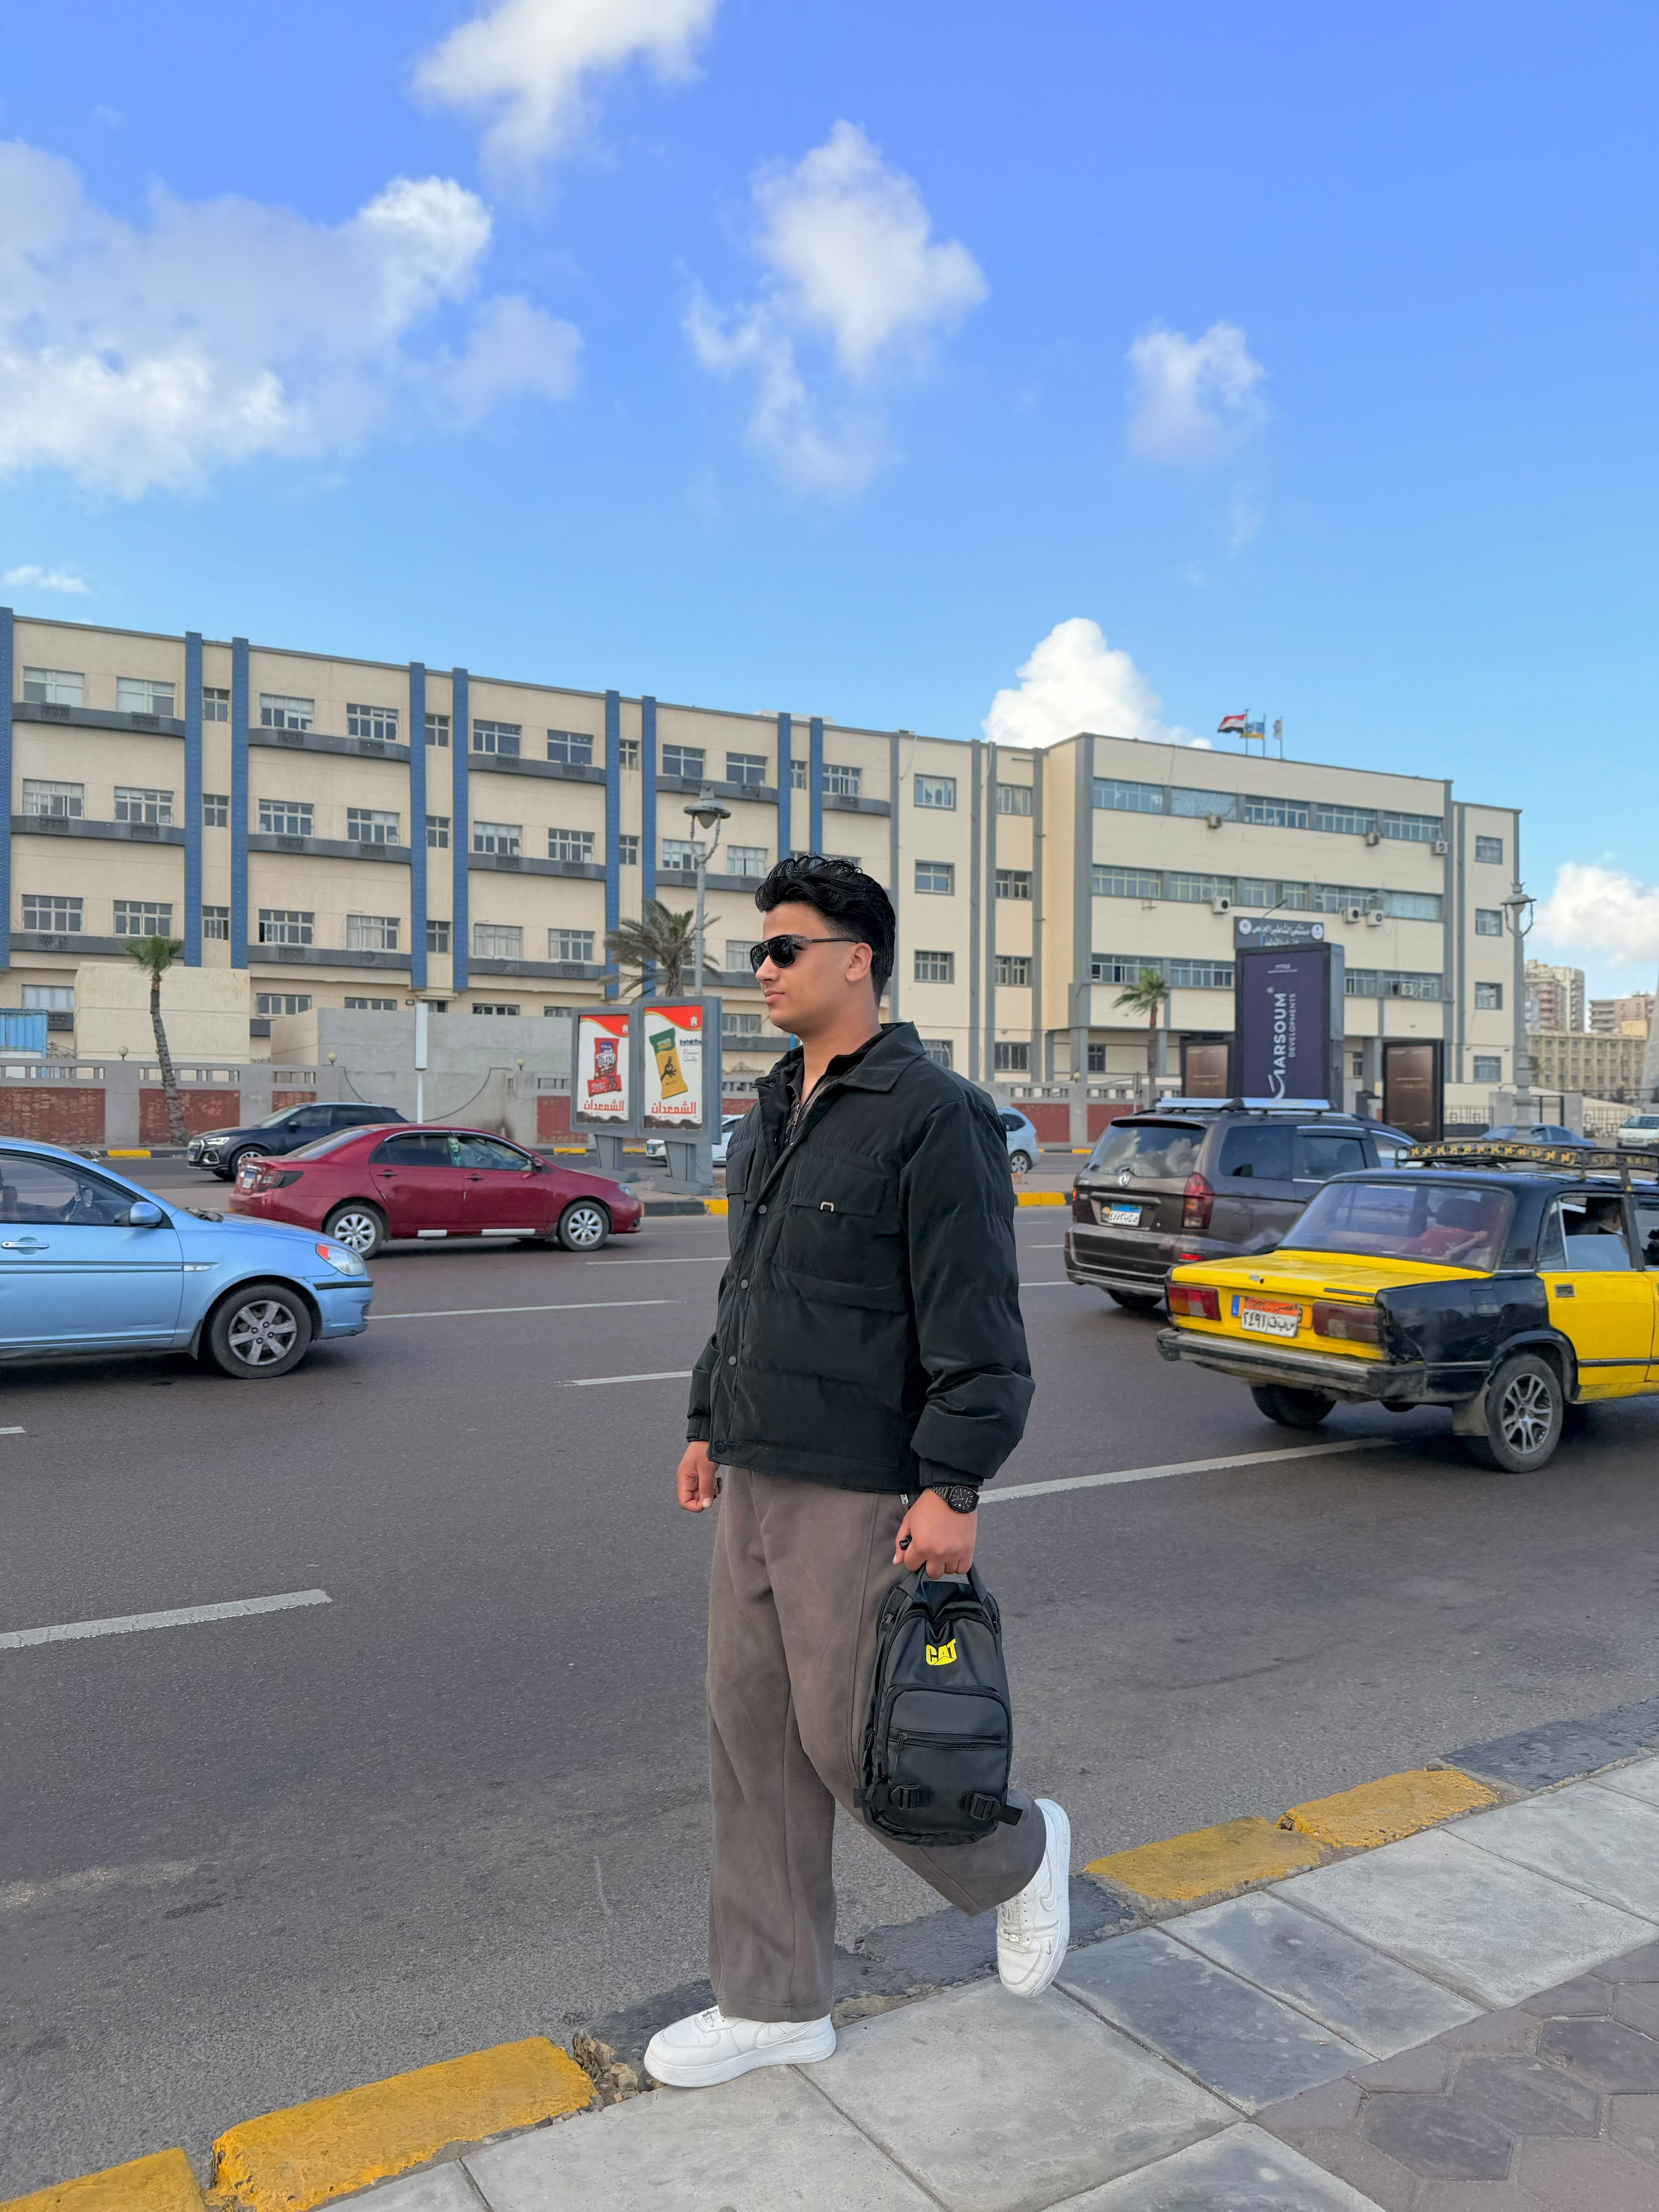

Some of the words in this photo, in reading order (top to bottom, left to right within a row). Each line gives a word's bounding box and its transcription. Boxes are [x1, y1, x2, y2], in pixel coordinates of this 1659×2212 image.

[584, 1099, 624, 1111] الشمعدان
[651, 1101, 696, 1114] الشمعدان
[1244, 1311, 1266, 1328] ٢٤٩١
[926, 1638, 957, 1665] CAT
